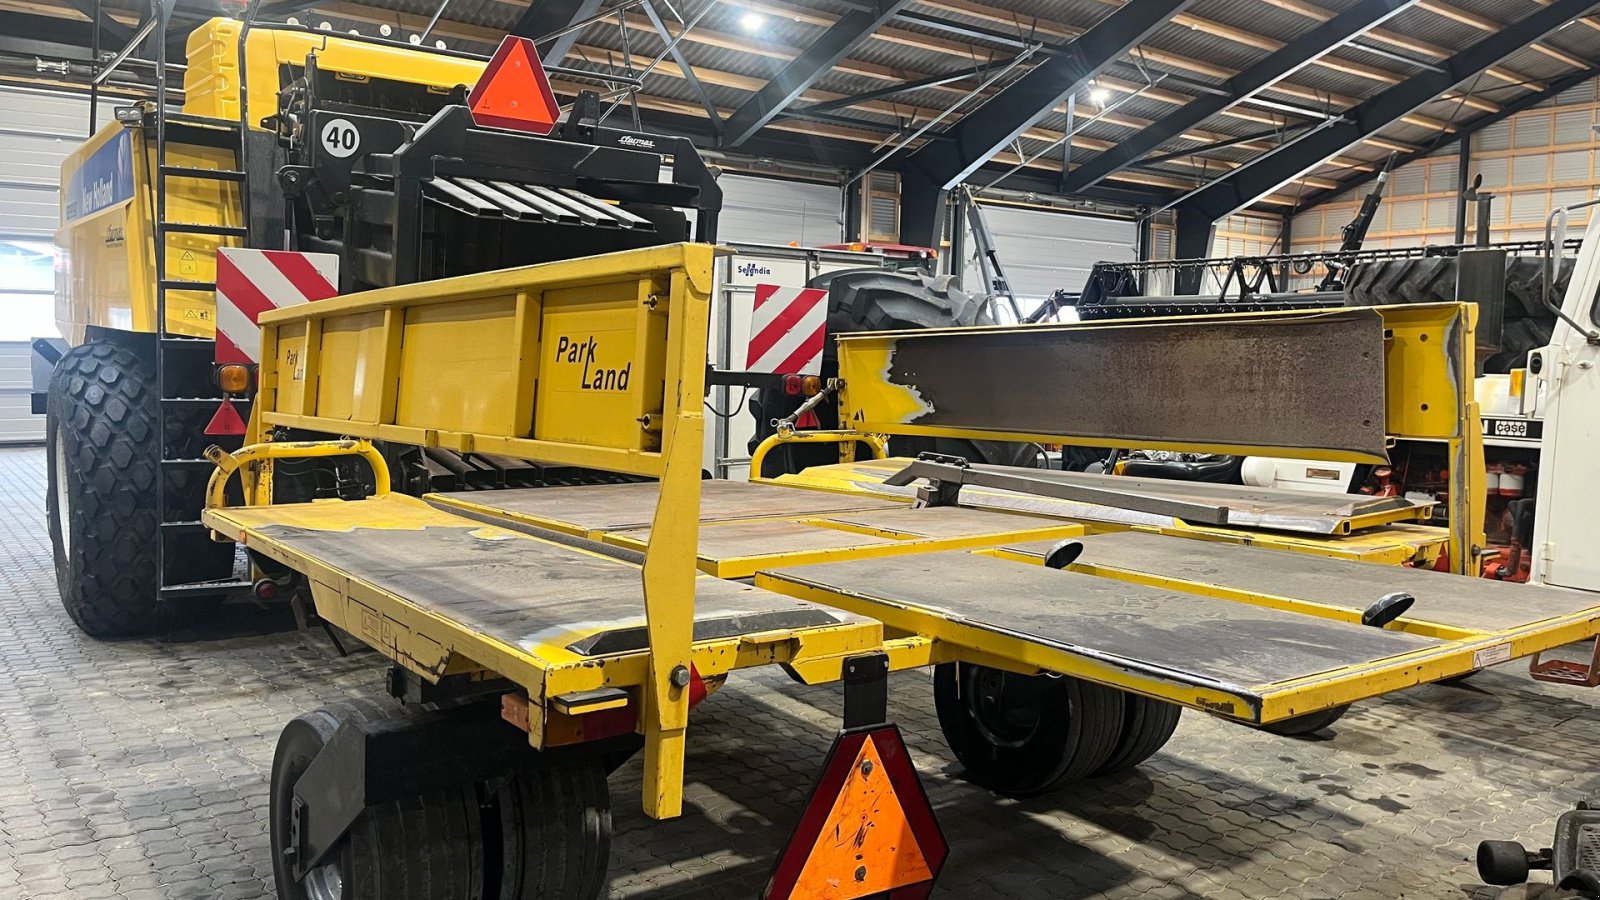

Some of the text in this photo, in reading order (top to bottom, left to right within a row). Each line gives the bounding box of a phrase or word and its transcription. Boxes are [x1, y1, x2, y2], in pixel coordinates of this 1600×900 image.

[326, 126, 356, 150] 40
[82, 186, 93, 214] New
[93, 172, 113, 211] Holland
[556, 335, 597, 363] Park
[581, 361, 631, 391] Land
[1496, 422, 1526, 434] case
